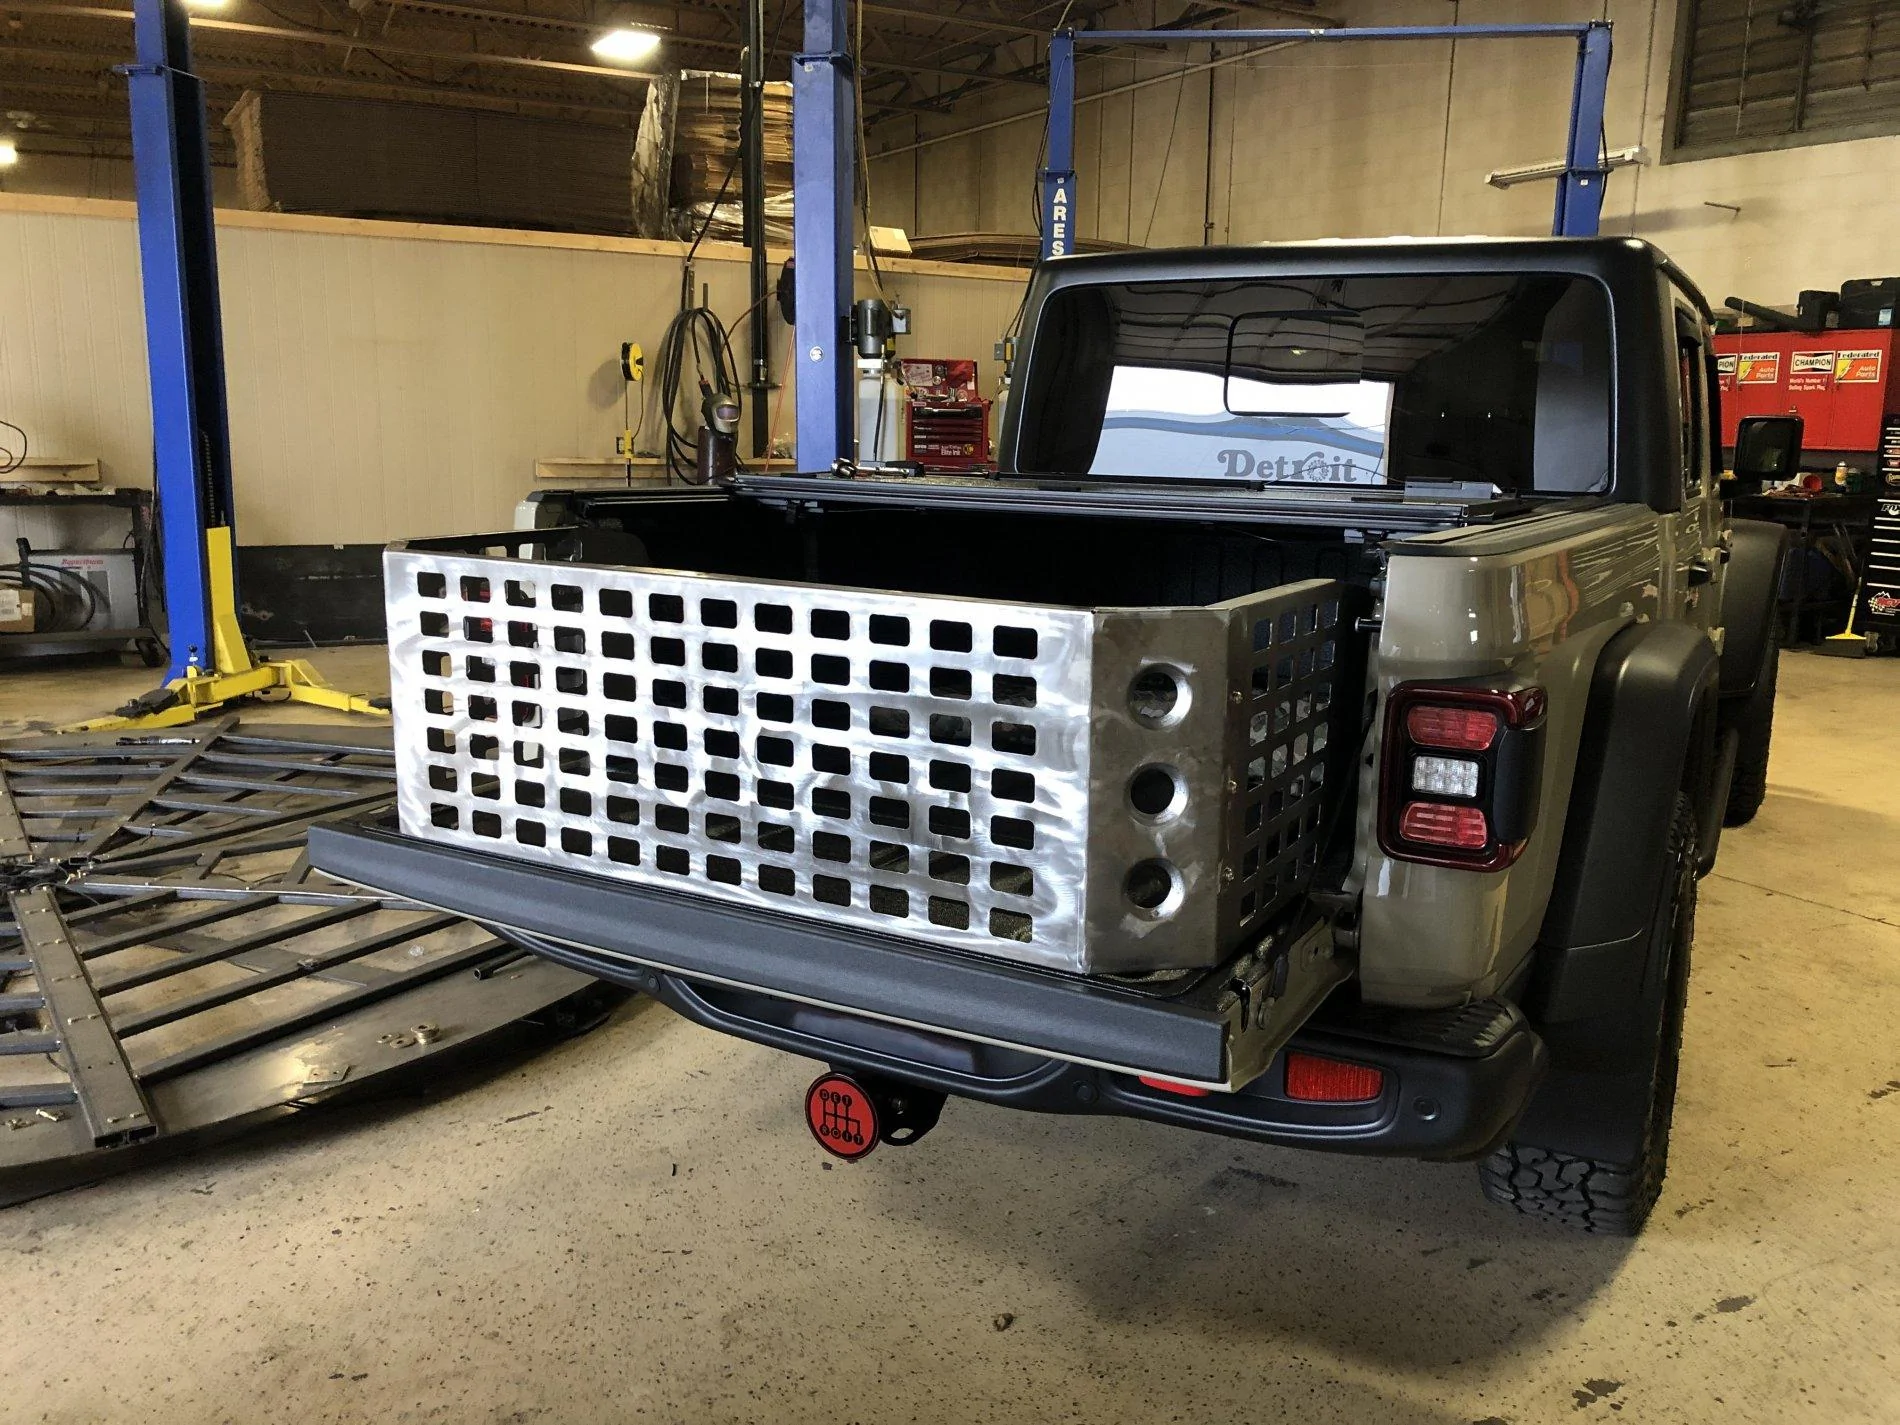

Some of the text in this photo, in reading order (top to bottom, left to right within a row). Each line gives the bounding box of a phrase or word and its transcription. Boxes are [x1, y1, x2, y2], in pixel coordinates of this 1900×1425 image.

[1718, 359, 1734, 368] PION
[1794, 358, 1831, 367] CHAMPION
[1856, 370, 1876, 378] Parts
[1217, 449, 1357, 482] Detroit
